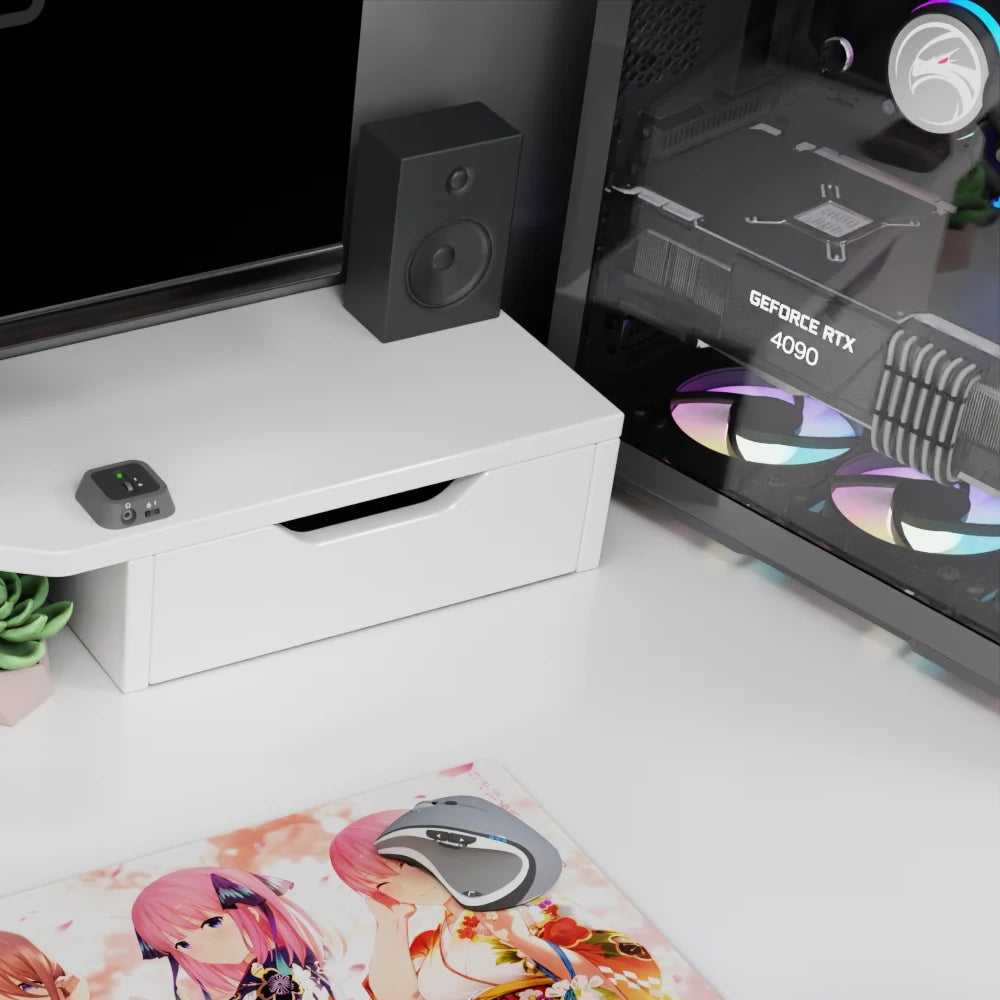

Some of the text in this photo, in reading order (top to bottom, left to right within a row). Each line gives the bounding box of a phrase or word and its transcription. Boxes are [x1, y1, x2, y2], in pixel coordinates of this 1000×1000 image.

[749, 289, 856, 354] GEFORCE RTX
[770, 331, 819, 366] 4090
